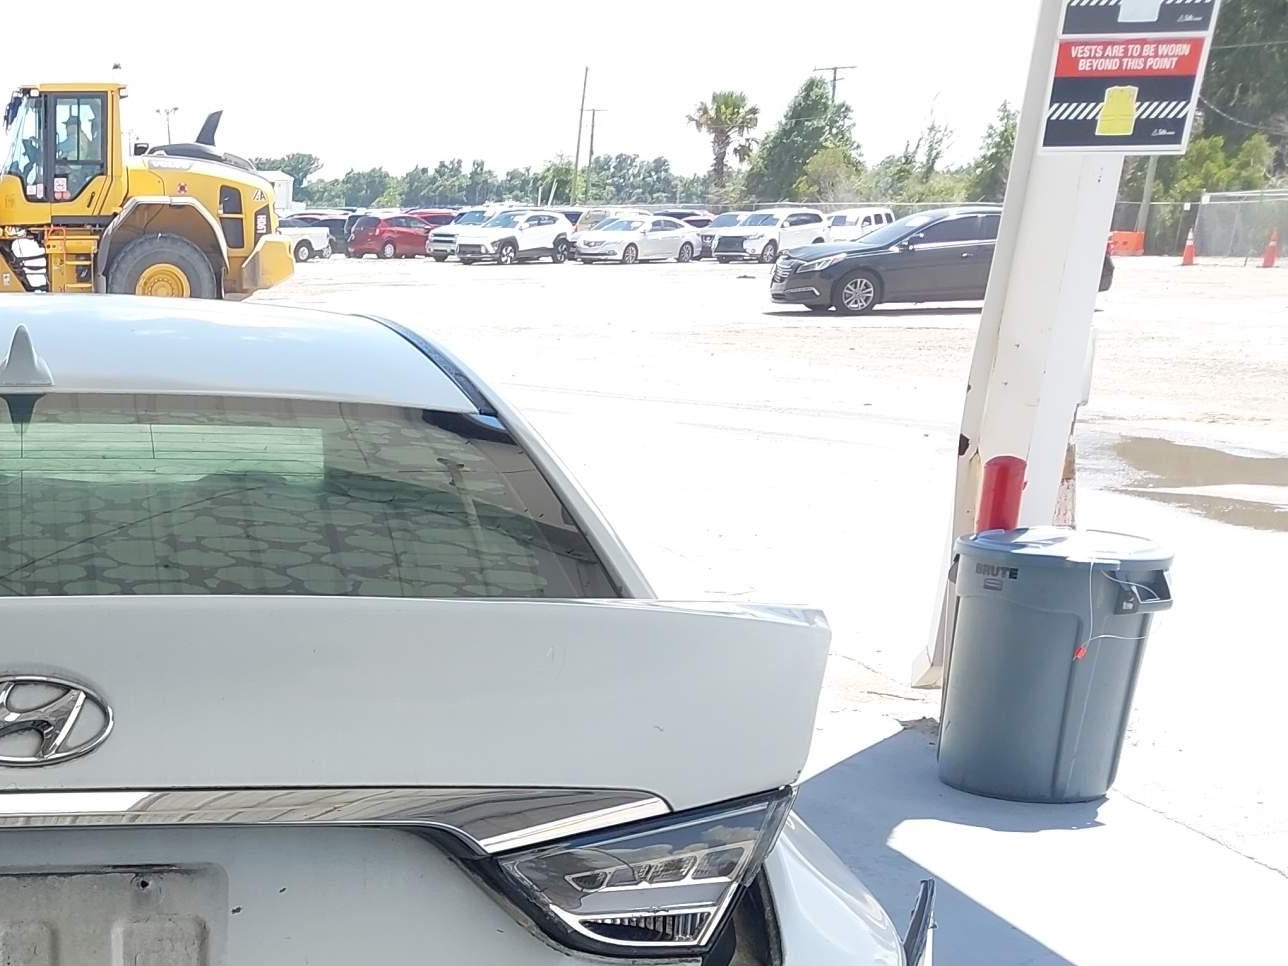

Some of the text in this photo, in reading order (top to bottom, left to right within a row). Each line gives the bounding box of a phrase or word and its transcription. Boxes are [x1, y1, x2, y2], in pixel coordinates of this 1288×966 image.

[1071, 43, 1191, 57] VESTS ARE TO BE WORN
[1078, 57, 1178, 71] BEYOND THIS POINT
[975, 562, 1018, 579] BRUTE
